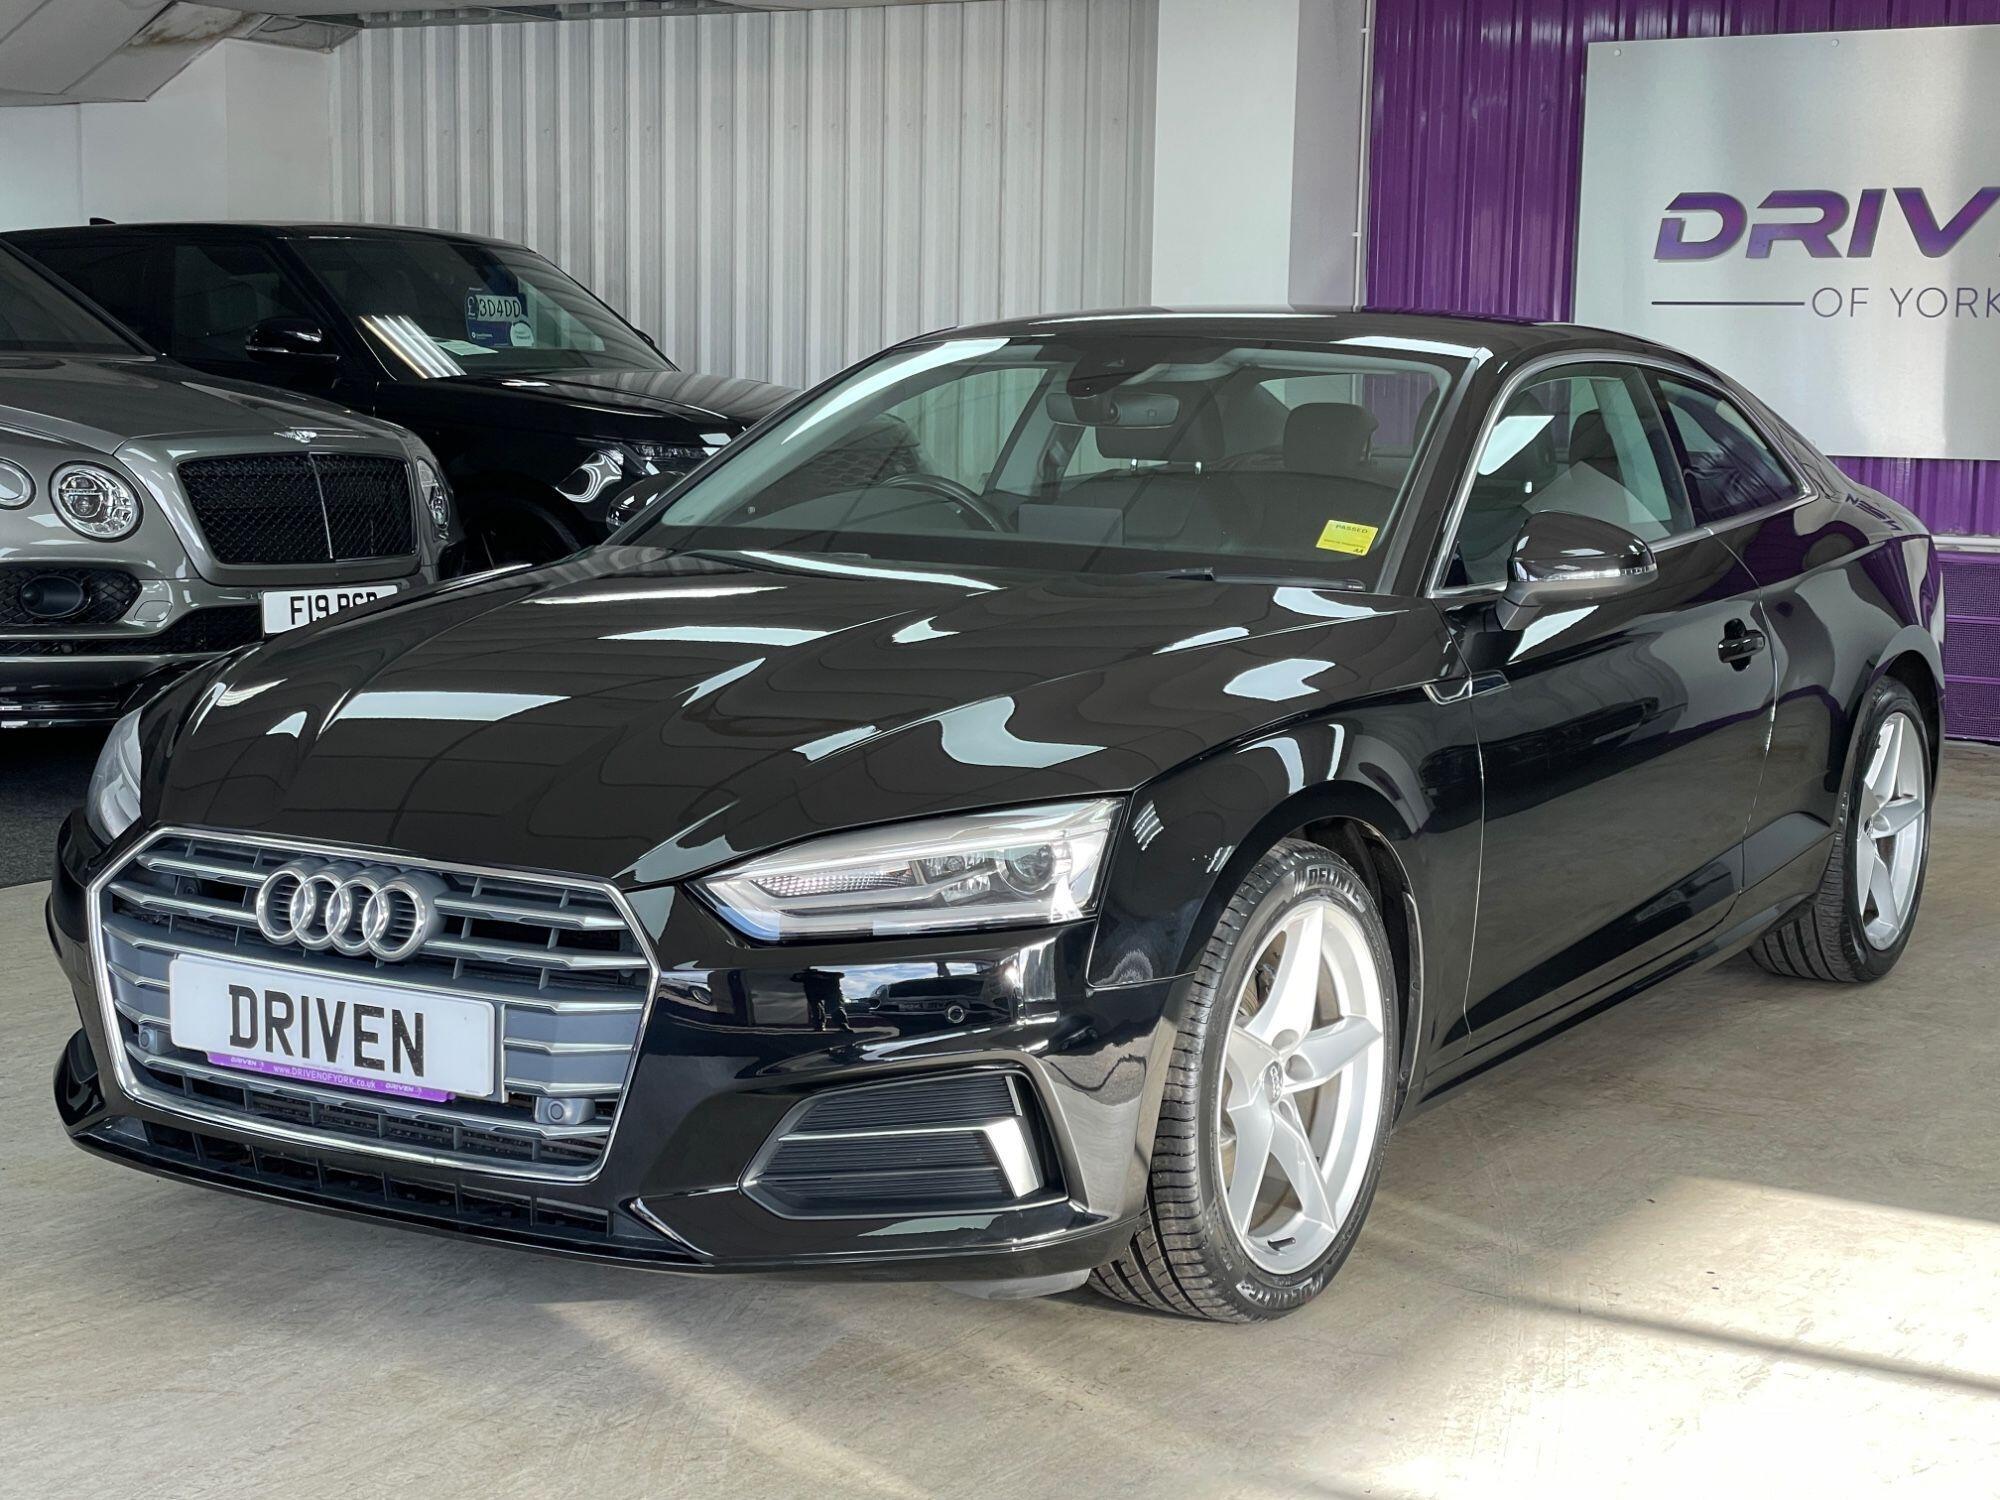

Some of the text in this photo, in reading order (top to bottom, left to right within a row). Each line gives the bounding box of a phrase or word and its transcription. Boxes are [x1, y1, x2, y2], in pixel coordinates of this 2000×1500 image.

[1653, 186, 2000, 260] DRIV
[1811, 287, 2000, 318] OF YORK
[228, 983, 424, 1078] DRIVEN
